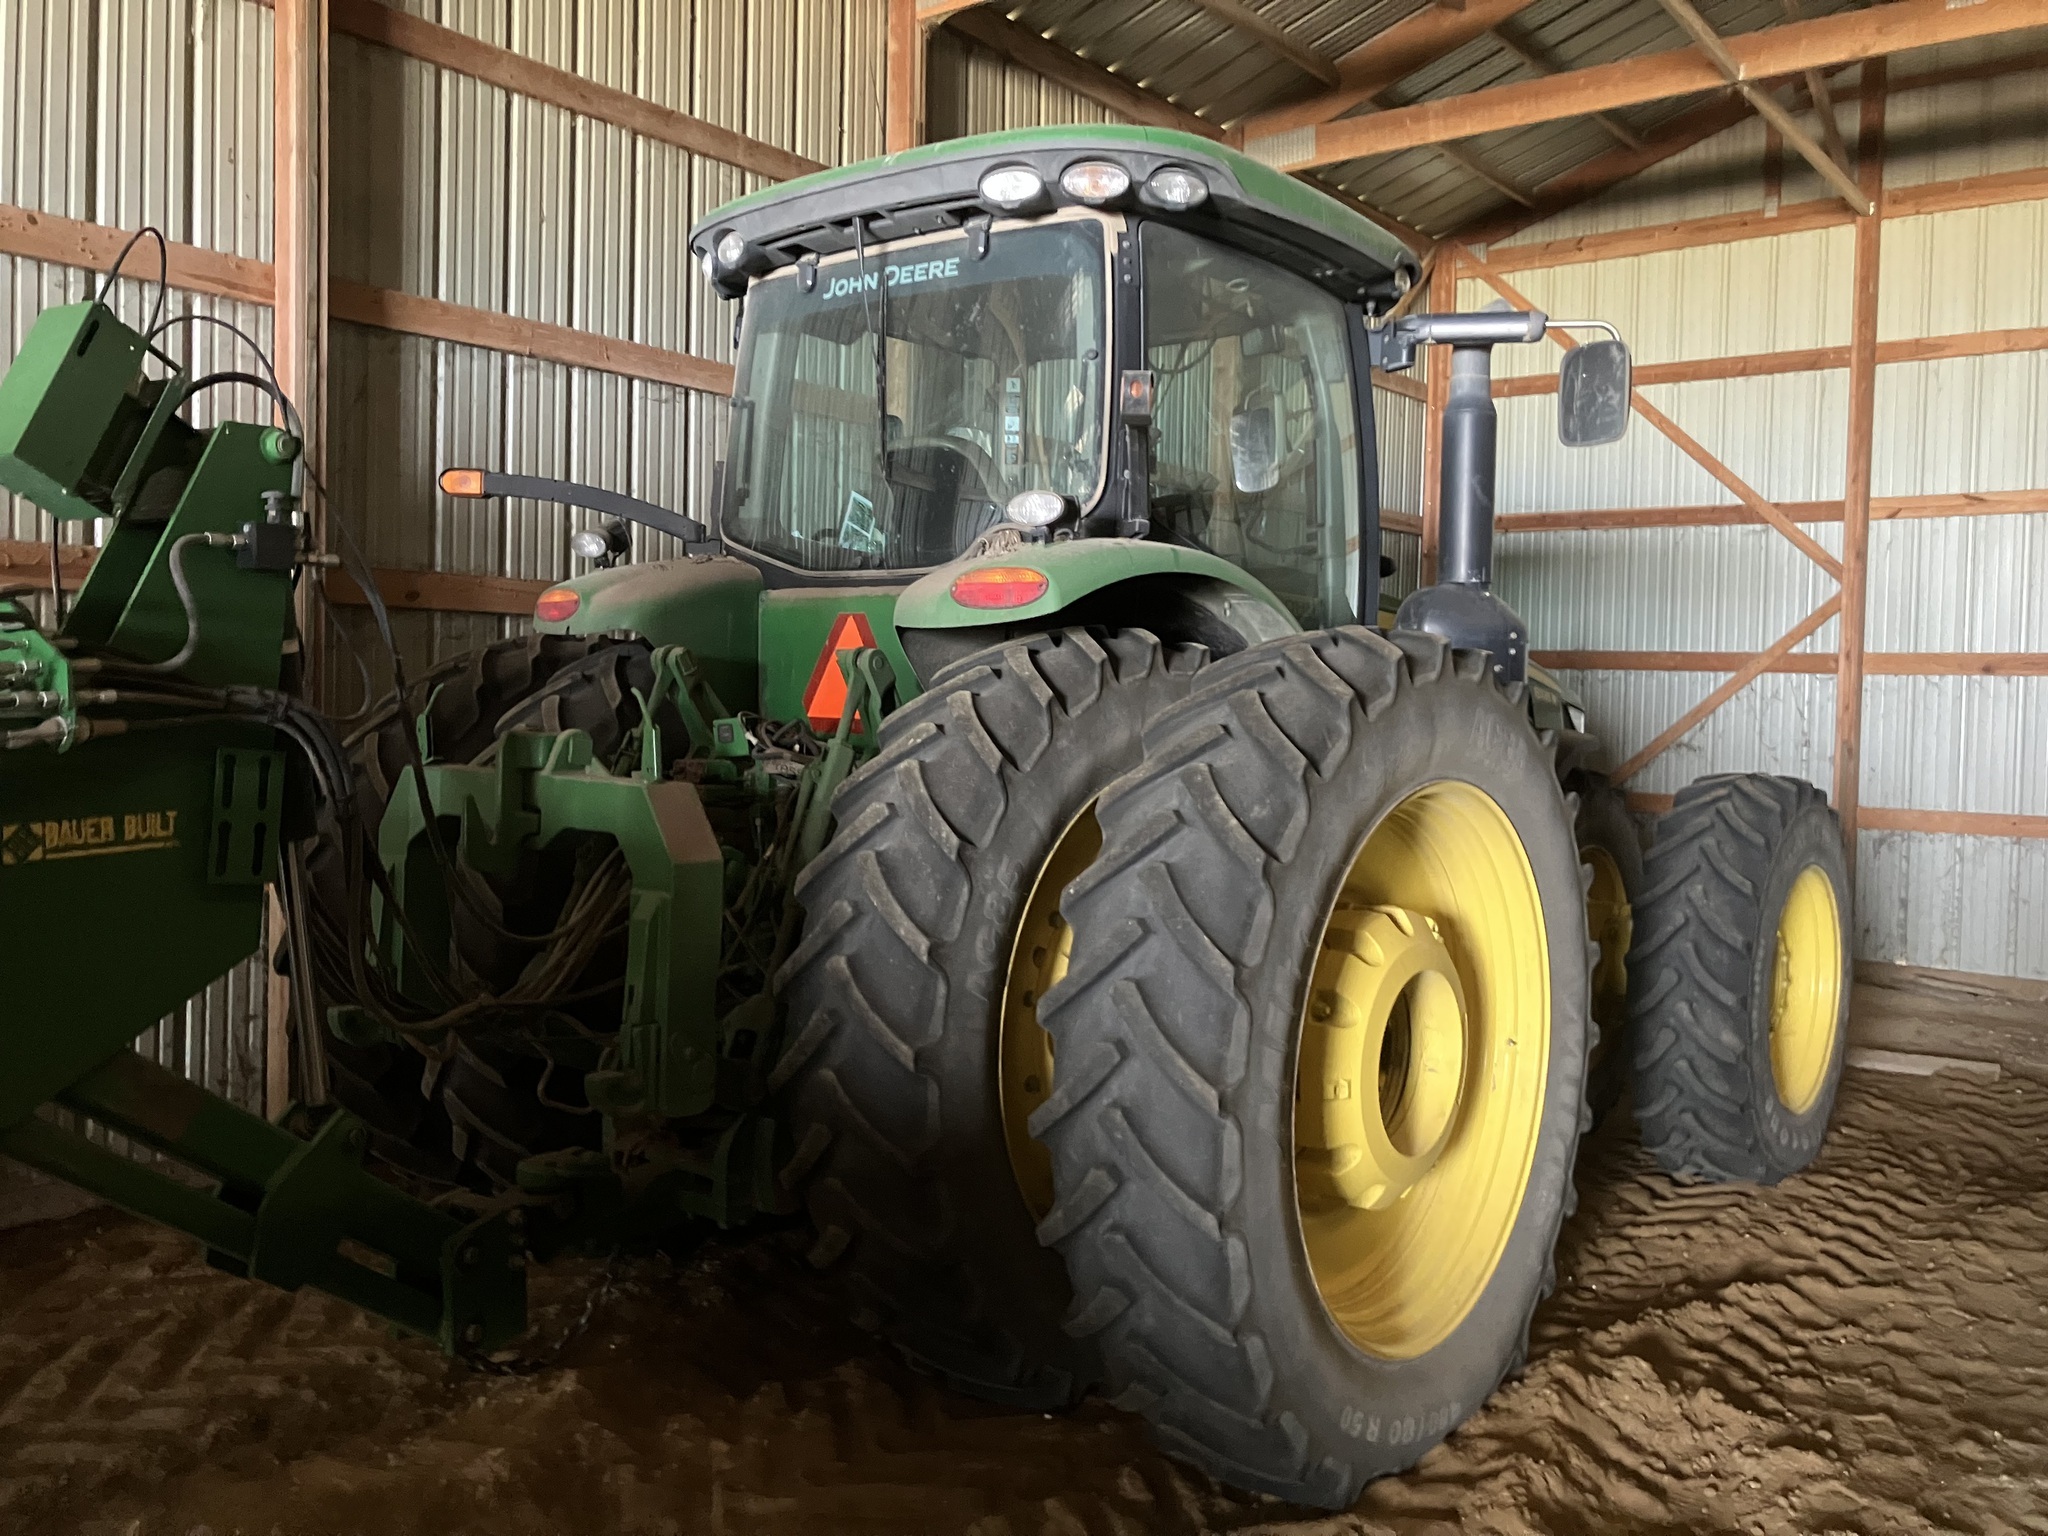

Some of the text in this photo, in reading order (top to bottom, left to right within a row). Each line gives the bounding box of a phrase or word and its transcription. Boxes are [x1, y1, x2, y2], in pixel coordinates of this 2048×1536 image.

[823, 257, 960, 300] JOHN DEERE
[45, 811, 178, 849] BAUER BUILT
